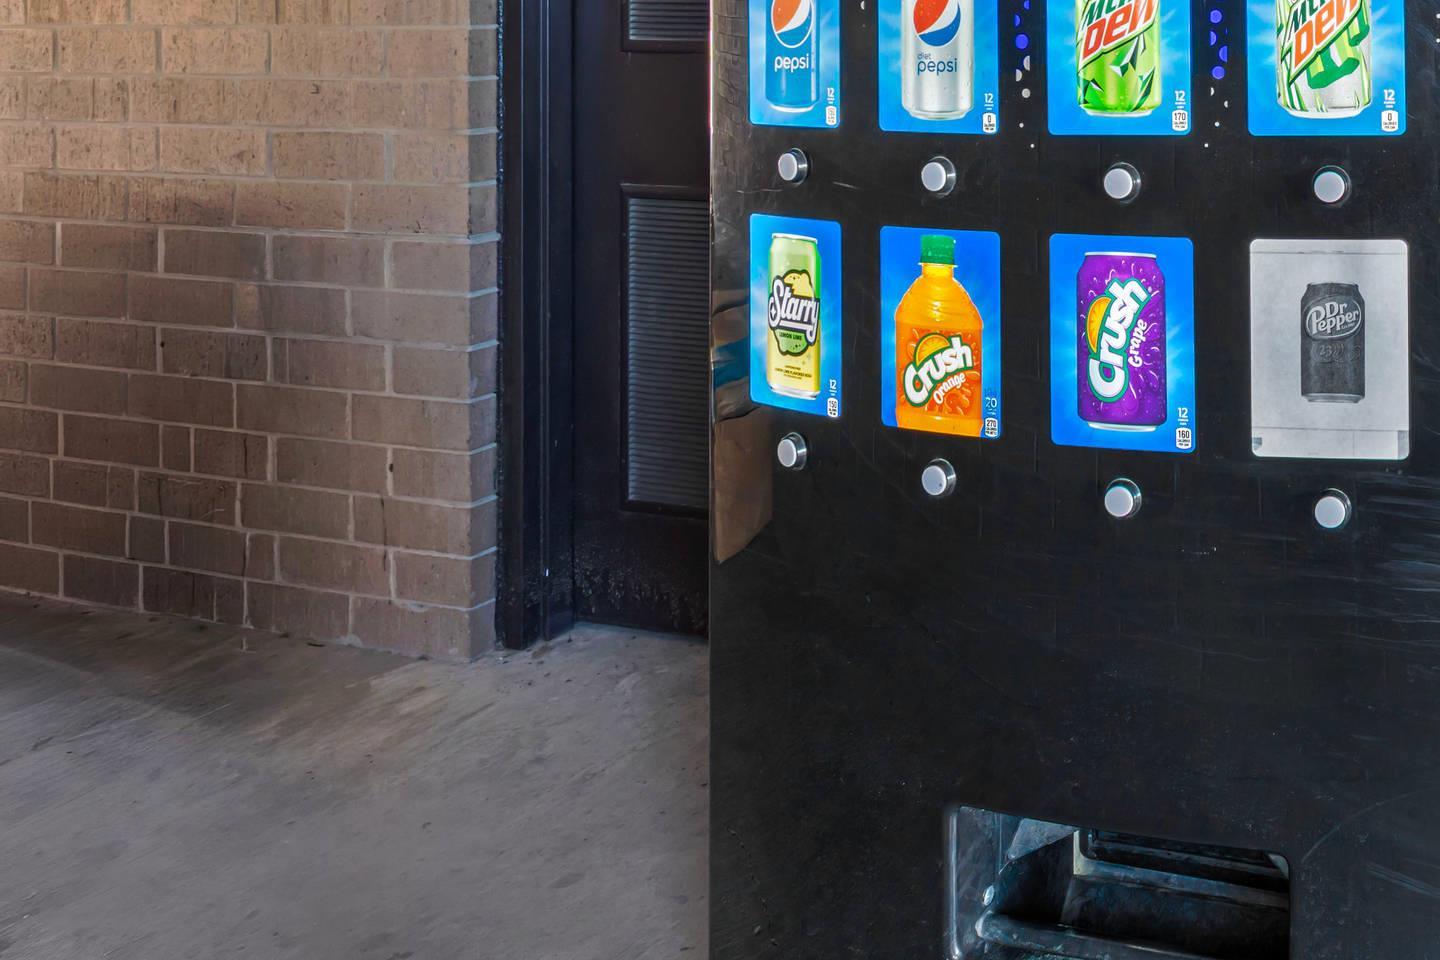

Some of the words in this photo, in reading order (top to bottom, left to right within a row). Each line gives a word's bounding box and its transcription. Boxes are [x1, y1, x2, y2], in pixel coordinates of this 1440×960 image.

[774, 53, 809, 72] pepsi
[917, 52, 931, 60] diet
[917, 58, 958, 75] pepsi
[827, 88, 834, 97] 12
[984, 93, 994, 103] 12
[1175, 90, 1185, 101] 12
[1384, 89, 1395, 100] 12
[769, 279, 820, 342] Starry
[1325, 302, 1347, 318] Dr
[1307, 306, 1359, 335] Pepper
[1088, 279, 1148, 397] Crush
[1128, 318, 1147, 367] Grape
[906, 336, 972, 403] Crush
[830, 379, 836, 389] 12
[986, 397, 997, 408] 20
[1178, 408, 1188, 418] 12
